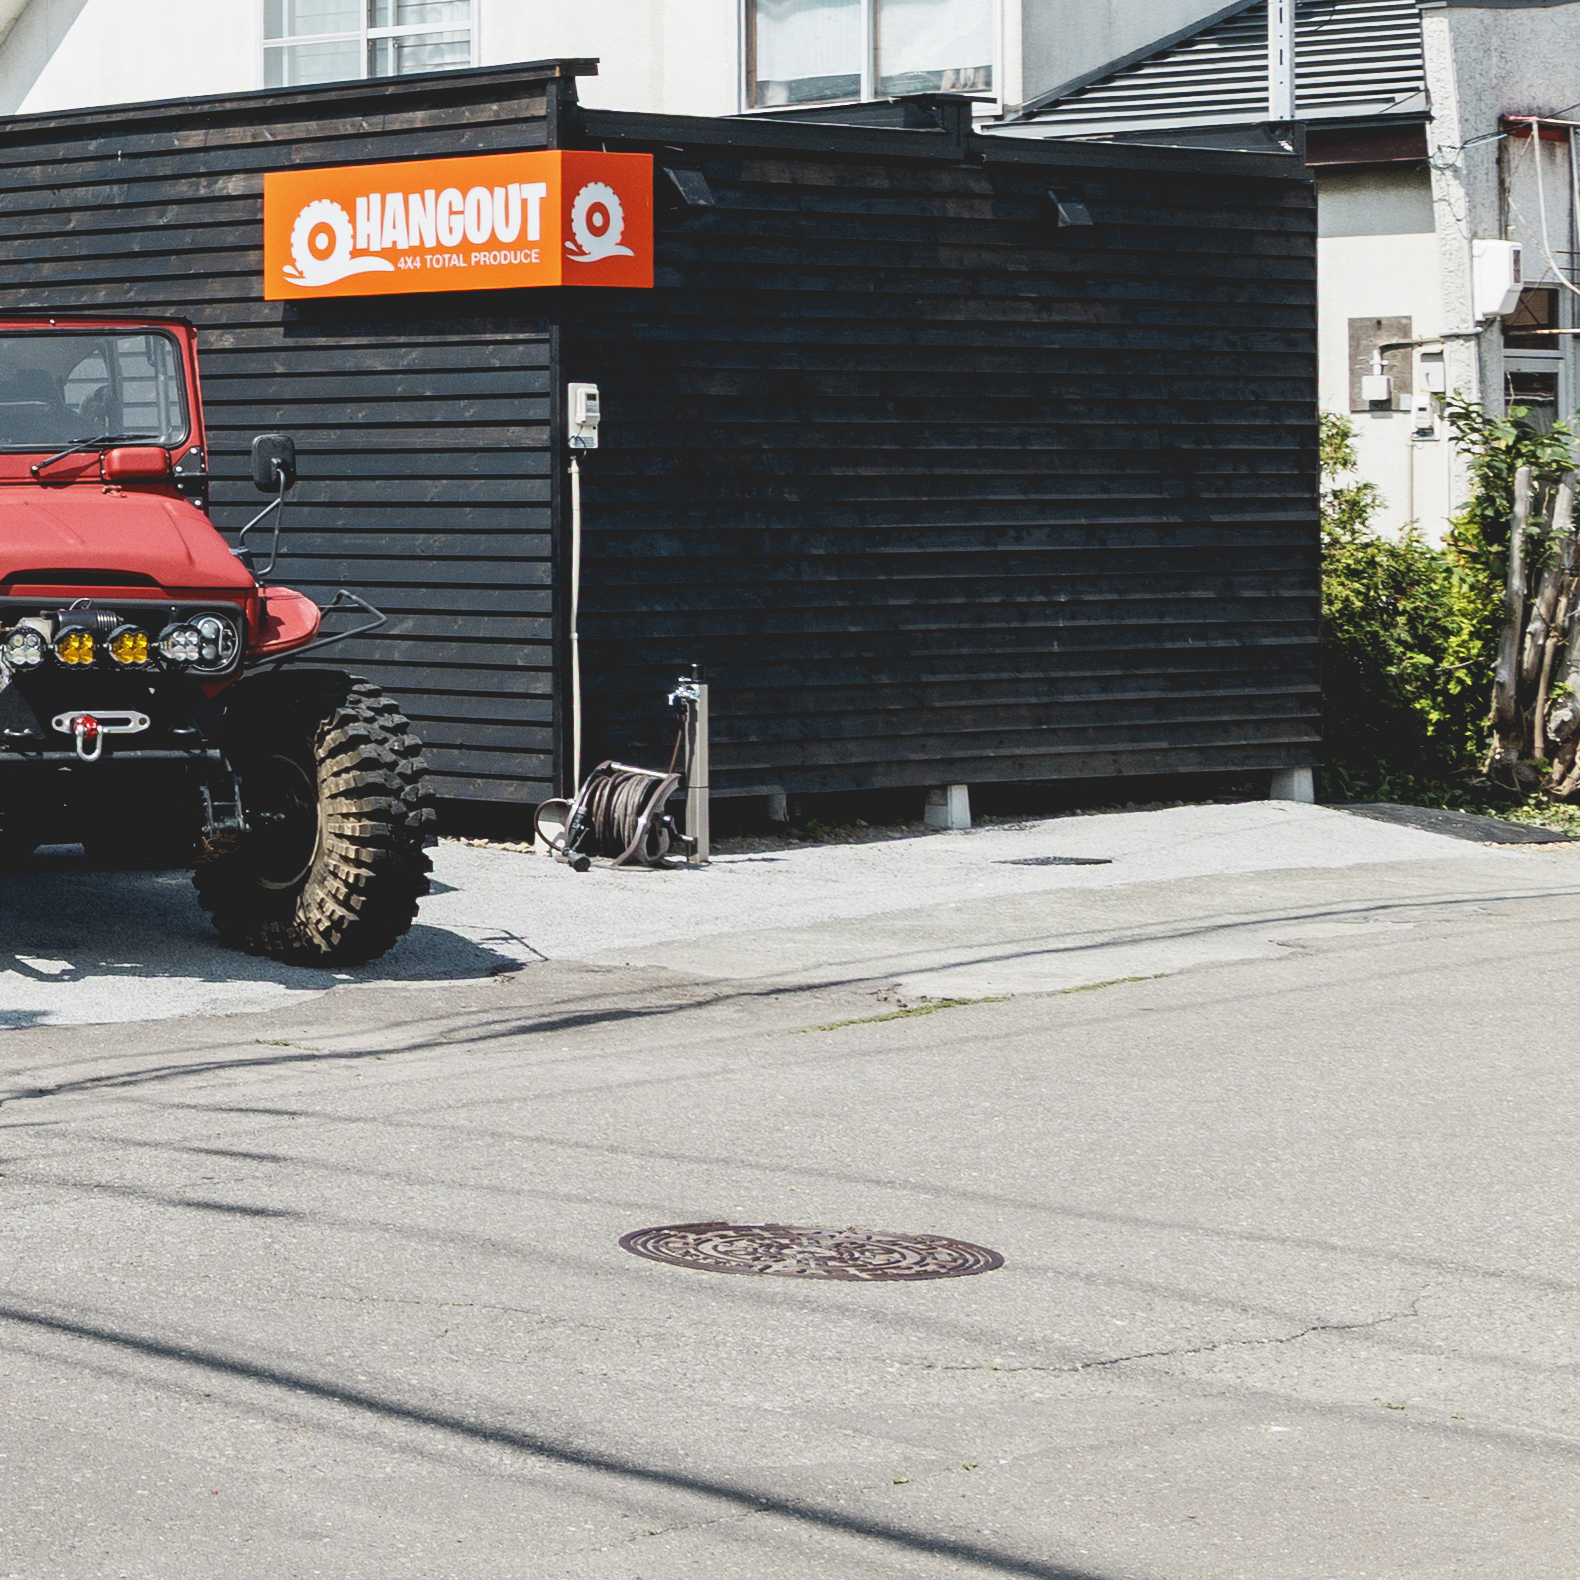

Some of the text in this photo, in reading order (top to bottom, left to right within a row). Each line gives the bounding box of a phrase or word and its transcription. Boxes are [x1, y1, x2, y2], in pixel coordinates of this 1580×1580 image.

[355, 182, 547, 251] HANGOUT
[397, 248, 540, 270] 4X4 TOTAL PRODUCE
